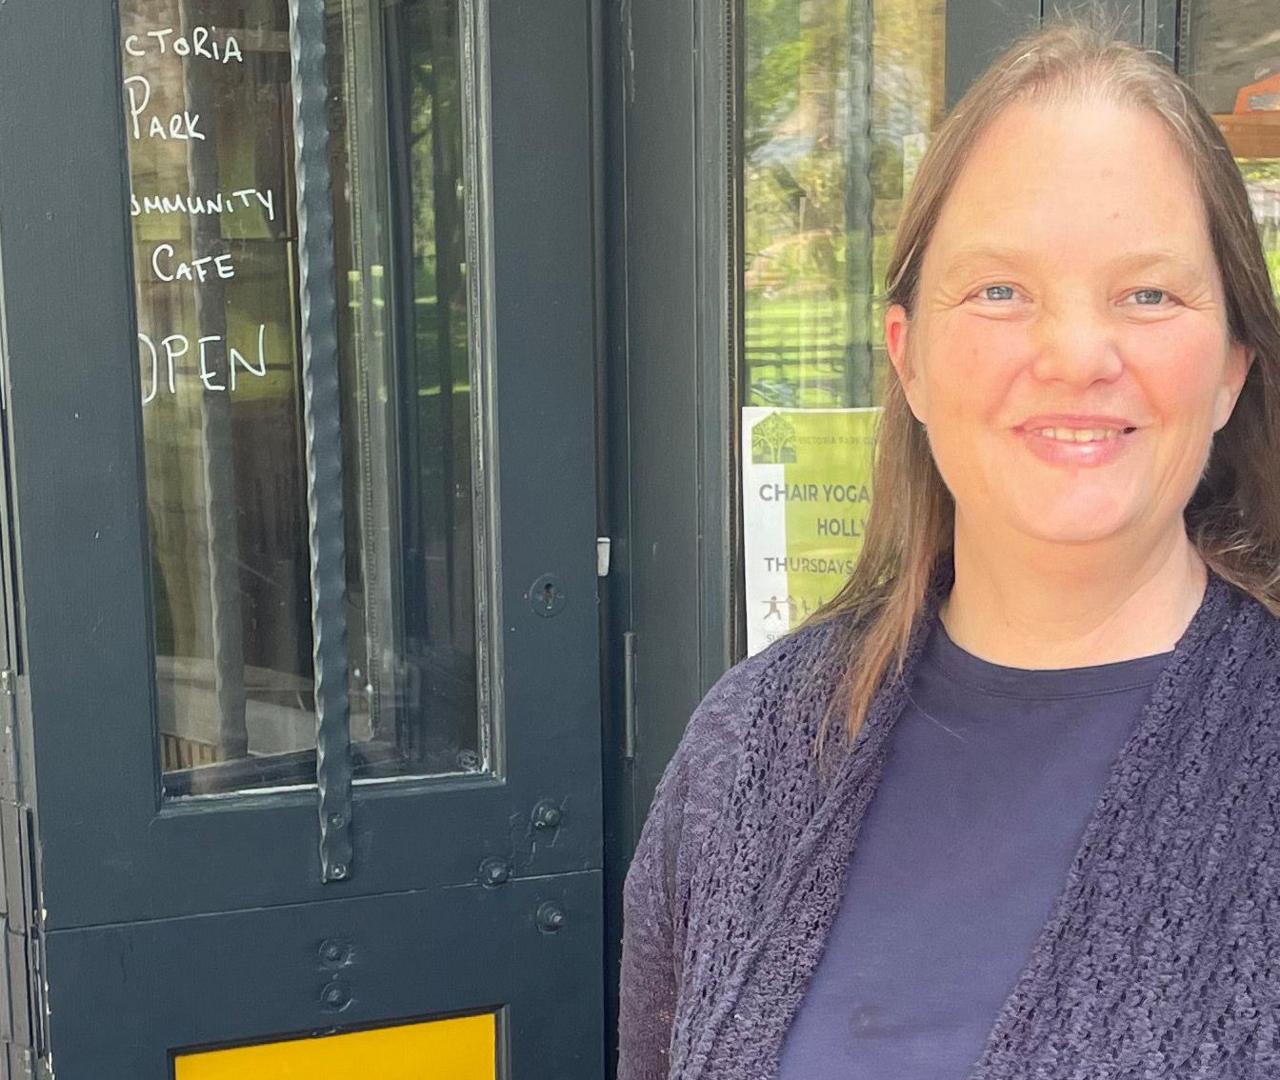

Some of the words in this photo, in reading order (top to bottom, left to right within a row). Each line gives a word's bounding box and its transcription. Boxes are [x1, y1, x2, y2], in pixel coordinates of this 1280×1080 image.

[125, 27, 243, 63] CTORIA
[124, 75, 205, 140] PARK
[152, 244, 234, 282] CAFE
[759, 484, 818, 502] CHAIR
[823, 485, 870, 503] YOGA
[763, 557, 853, 574] THURSDAYS
